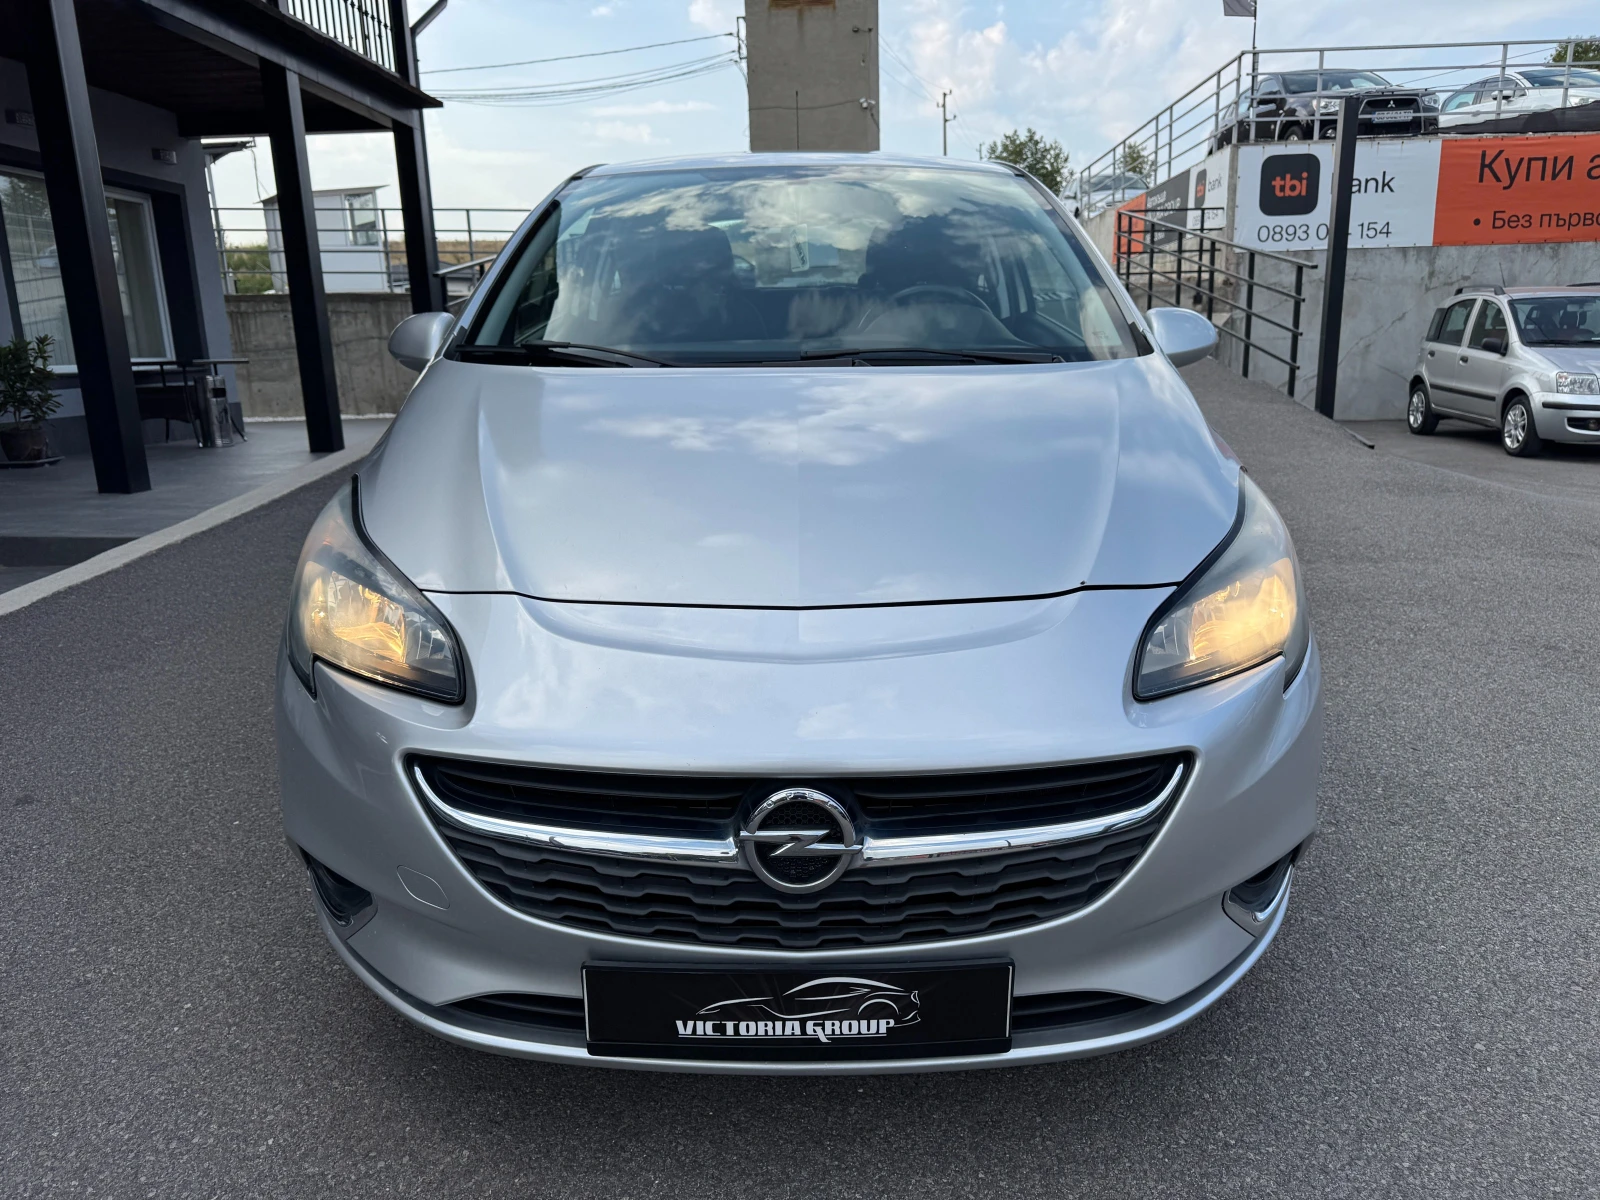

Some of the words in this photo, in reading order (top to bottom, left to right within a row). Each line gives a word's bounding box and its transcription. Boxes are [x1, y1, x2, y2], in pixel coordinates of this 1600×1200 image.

[1478, 149, 1574, 190] Купи
[1272, 171, 1309, 197] tbi
[1331, 170, 1396, 194] ank
[1492, 210, 1533, 229] Без
[1257, 223, 1310, 242] 0893
[1358, 221, 1392, 239] 154
[766, 791, 832, 808] OPEL
[675, 1020, 801, 1036] VICTORIA
[805, 1019, 895, 1042] GROUP
